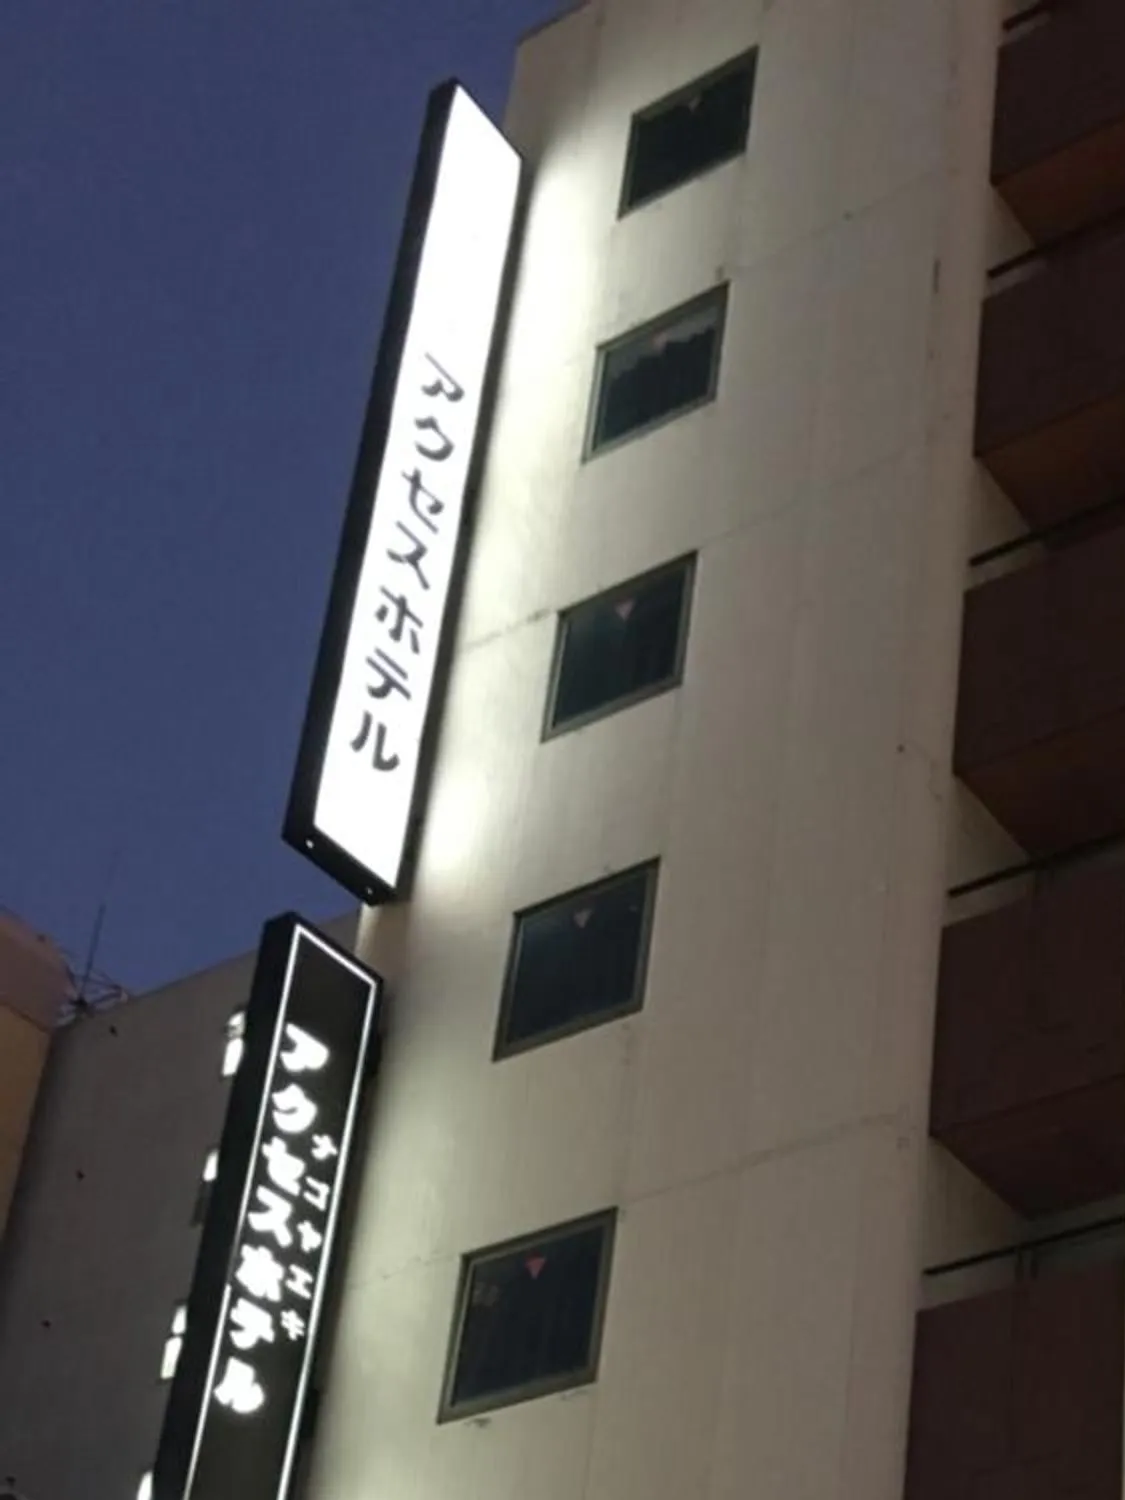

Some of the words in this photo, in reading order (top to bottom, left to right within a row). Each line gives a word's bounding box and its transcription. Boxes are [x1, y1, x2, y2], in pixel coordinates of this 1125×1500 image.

[350, 353, 465, 772] アクセスホテル
